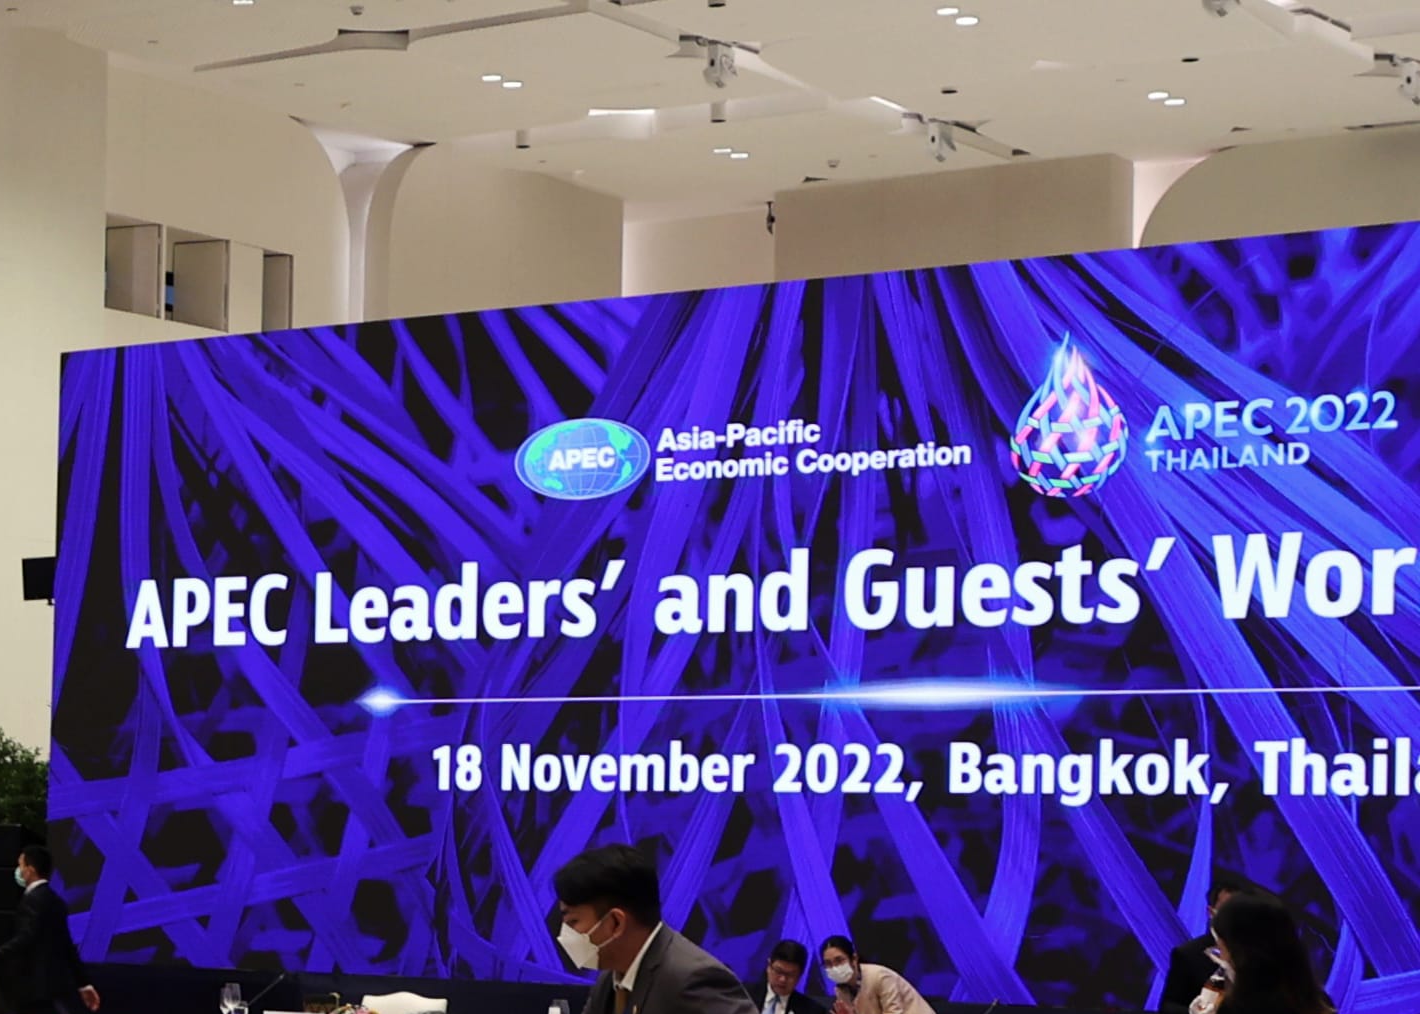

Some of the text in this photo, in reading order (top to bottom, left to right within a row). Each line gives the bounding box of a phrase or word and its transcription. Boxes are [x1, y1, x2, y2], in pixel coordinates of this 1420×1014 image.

[656, 418, 821, 452] Asia-Pacific
[1144, 390, 1399, 444] APEC 2022
[547, 446, 616, 472] APEC
[655, 440, 972, 482] Economic Cooperation
[1144, 442, 1311, 472] THAILAND
[125, 531, 1418, 649] APEC Leaders’ and Guests’ Wor
[433, 737, 1420, 807] 18 November 2022, Bangkok, Thail
